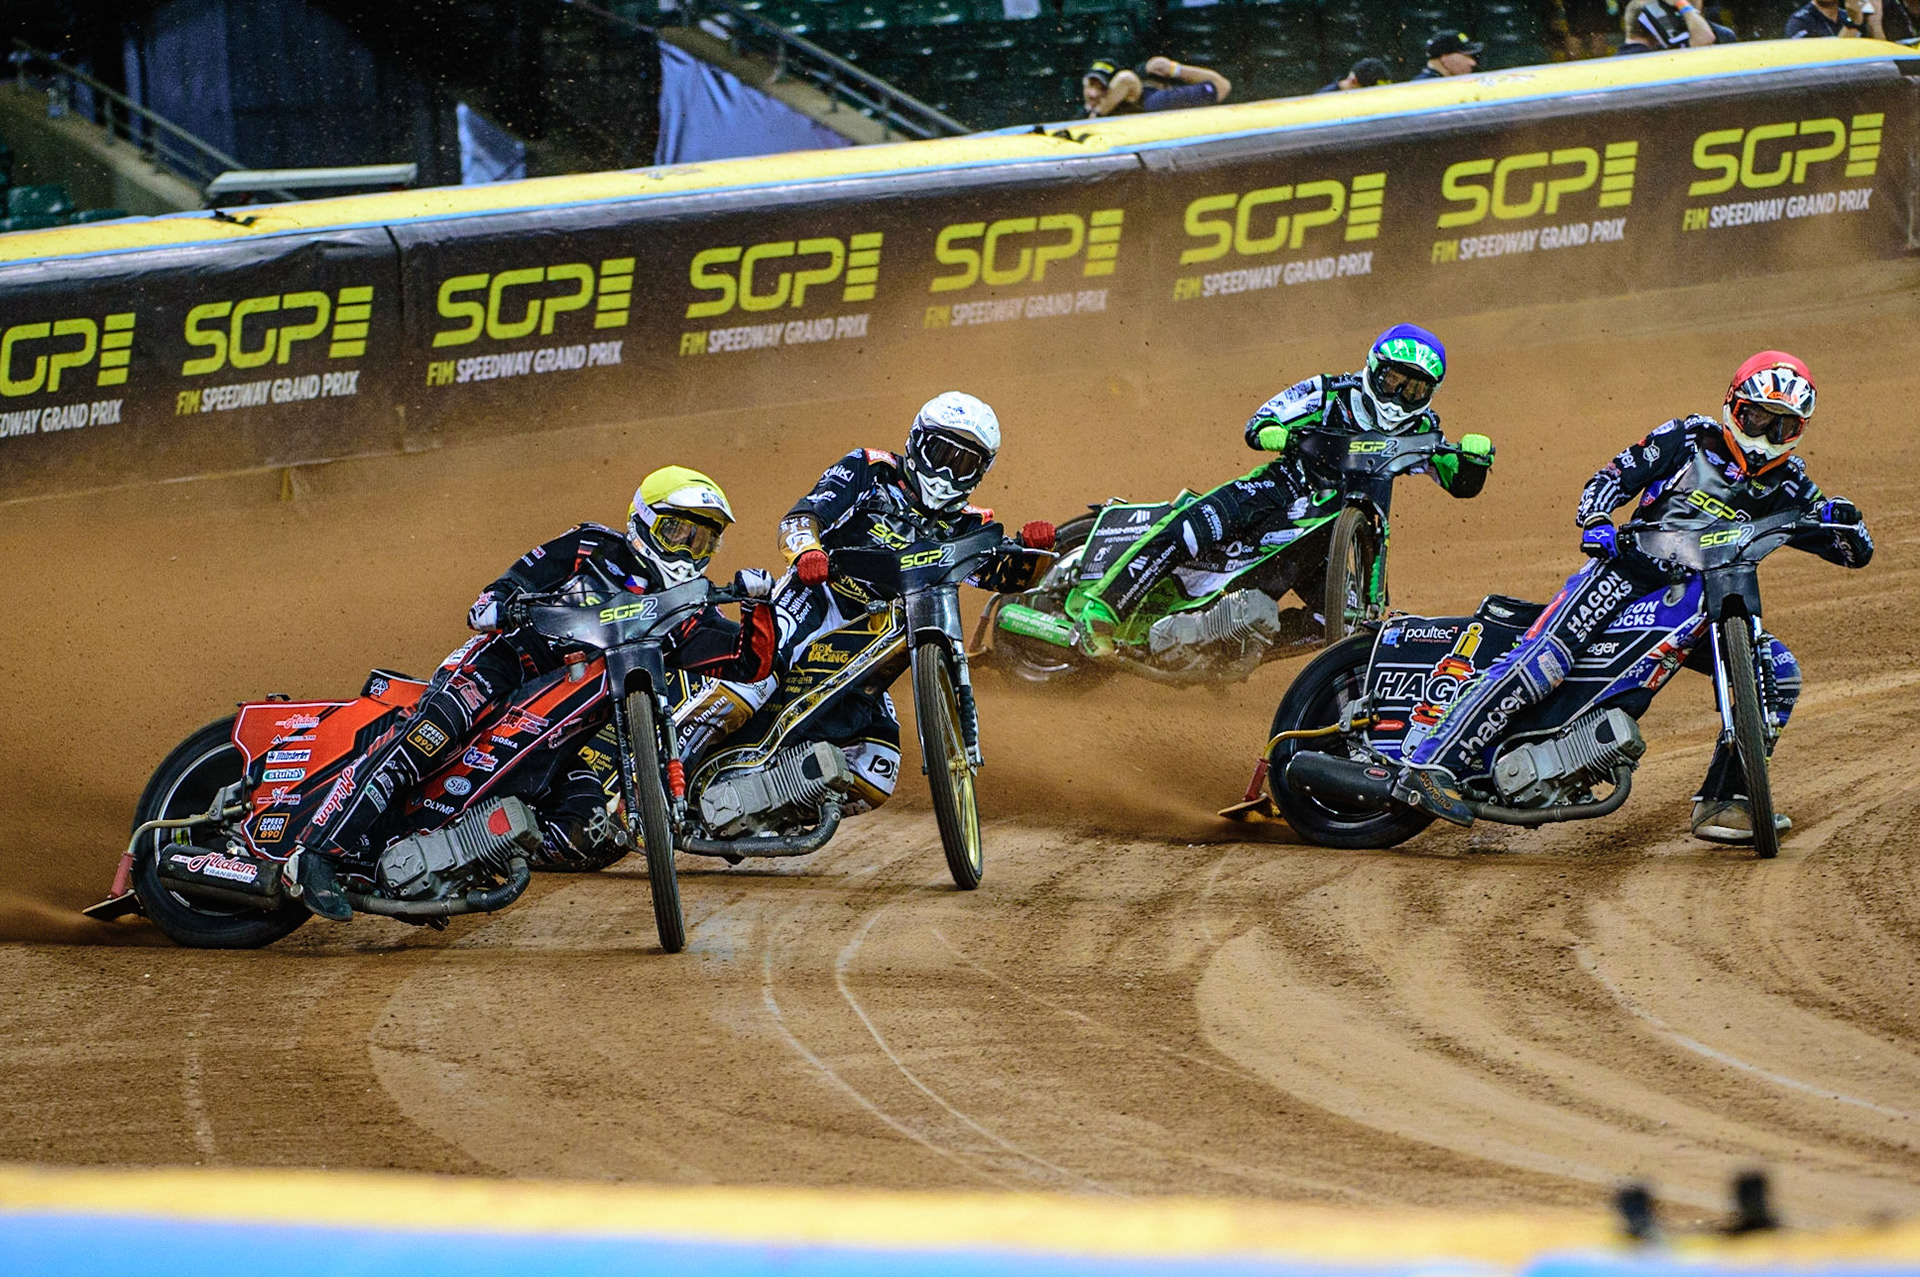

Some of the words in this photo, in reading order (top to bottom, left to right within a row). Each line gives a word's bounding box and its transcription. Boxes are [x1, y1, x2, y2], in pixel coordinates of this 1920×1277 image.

[1689, 118, 1848, 197] SGP
[1438, 147, 1601, 229] SGP
[1682, 207, 1709, 231] FIM
[1709, 199, 1787, 229] SPEEDWAY
[1787, 194, 1837, 221] GRAND
[1838, 188, 1873, 212] PRIX
[1179, 180, 1346, 265] SGP
[1431, 240, 1459, 264] FIM
[1459, 229, 1540, 260] SPEEDWAY
[1540, 223, 1589, 249] GRAND
[1588, 217, 1626, 242] PRIX
[930, 213, 1086, 293] SGP
[685, 237, 845, 319] SGP
[1174, 278, 1201, 300] FIM
[1201, 264, 1283, 296] SPEEDWAY
[1284, 257, 1336, 285] GRAND
[1337, 251, 1374, 277] PRIX
[432, 263, 595, 348] SGP
[182, 292, 331, 376] SGP
[679, 331, 706, 356] FIM
[707, 323, 782, 354] SPEEDWAY
[784, 318, 835, 344] GRAND
[835, 313, 869, 340] PRIX
[0, 318, 97, 397] GP
[426, 360, 455, 385] FIM
[455, 349, 532, 383] SPEEDWAY
[533, 344, 587, 373] GRAND
[587, 341, 623, 366] PRIX
[176, 390, 202, 416] FIM
[201, 380, 272, 412] SPEEDWAY
[271, 376, 321, 404] GRAND
[321, 371, 360, 396] PRIX
[41, 405, 90, 432] GRAND
[89, 400, 123, 426] PRIX
[900, 543, 956, 569] SGP2
[1700, 524, 1755, 548] SGP2
[600, 597, 659, 624] SGP2
[796, 602, 813, 623] Sport
[1566, 571, 1623, 634] HAGON
[1576, 580, 1634, 644] SHOCKS
[1404, 626, 1454, 643] poultec
[1587, 641, 1620, 655] ager
[414, 734, 434, 751] 890
[417, 729, 441, 747] CLEAN
[422, 723, 445, 741] SPEED
[315, 766, 355, 826] Midam
[423, 799, 455, 816] OLYMP
[259, 823, 283, 832] CLEAN
[260, 830, 280, 838] 890
[262, 817, 285, 826] SPEED
[188, 852, 258, 876] Midam
